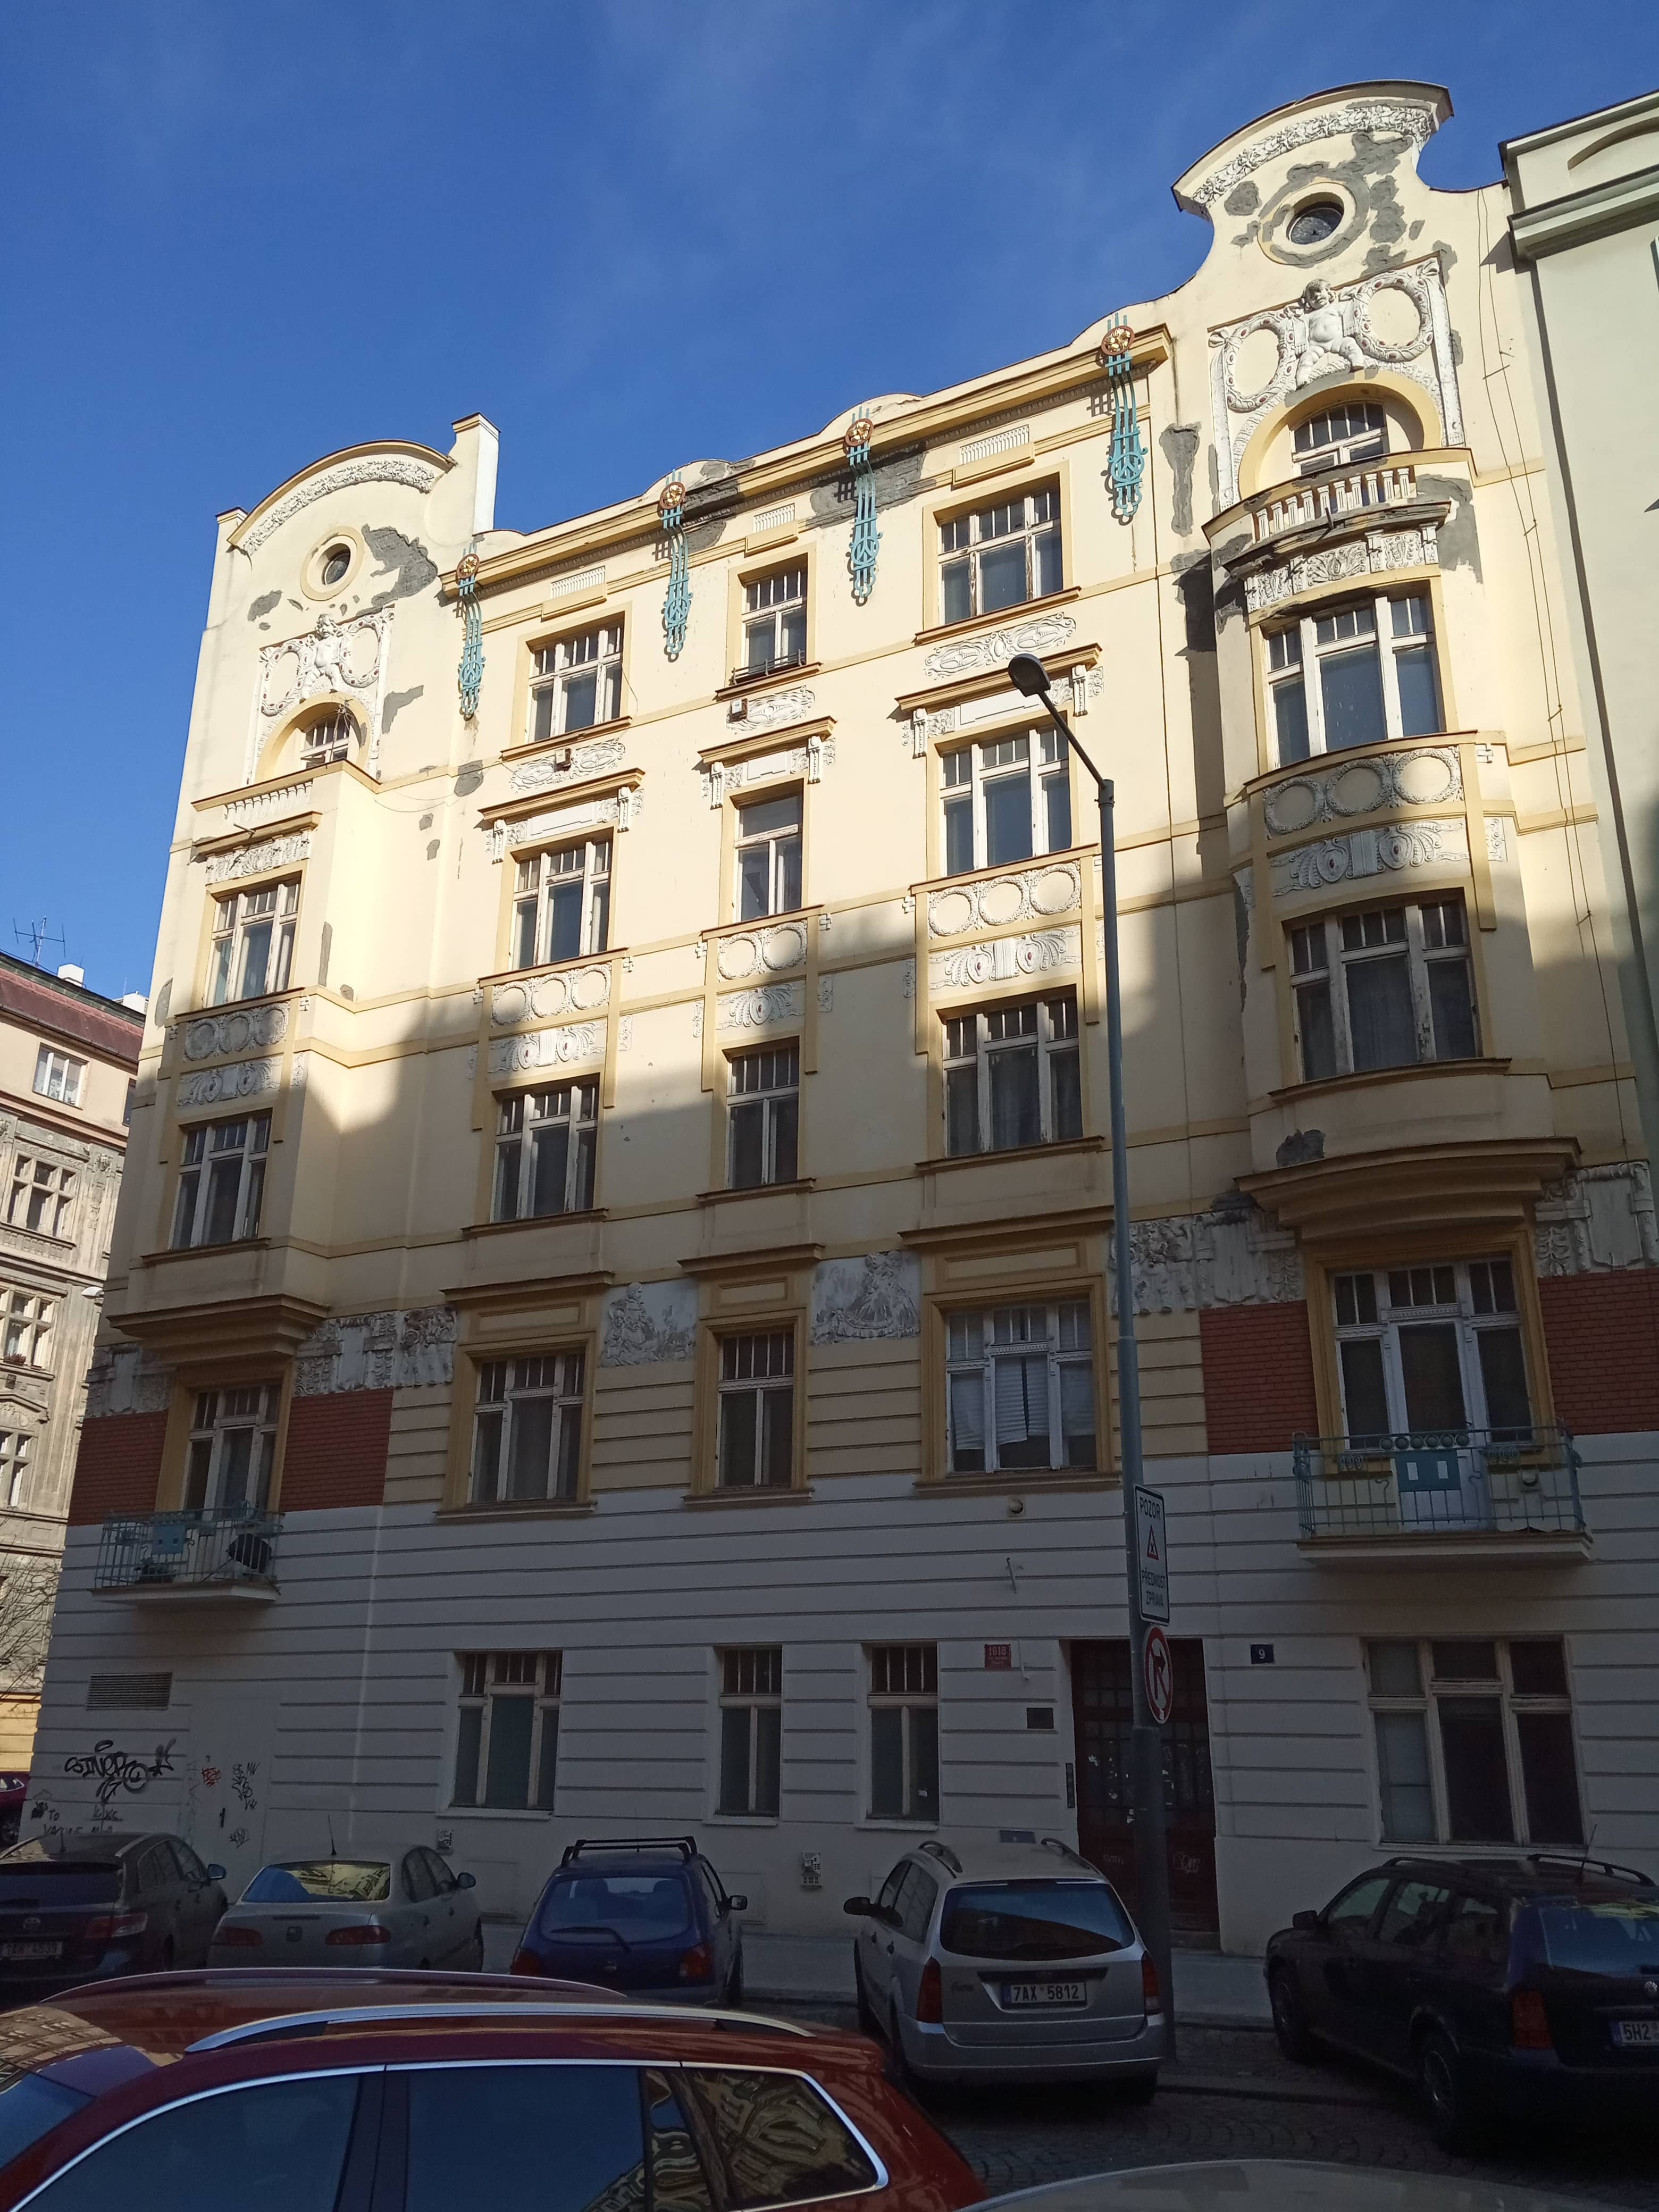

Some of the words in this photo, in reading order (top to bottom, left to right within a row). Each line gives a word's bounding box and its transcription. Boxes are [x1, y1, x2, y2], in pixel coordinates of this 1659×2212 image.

[1139, 1496, 1161, 1520] POZOR
[1142, 1567, 1166, 1589] PŘEDNOST
[1146, 1590, 1164, 1608] ZPRAVA
[989, 1646, 1007, 1655] 1618
[1259, 1648, 1266, 1660] 9
[1015, 1985, 1037, 2001] 7AX
[1047, 1985, 1079, 2000] 5812
[1623, 2023, 1652, 2040] 5H2
